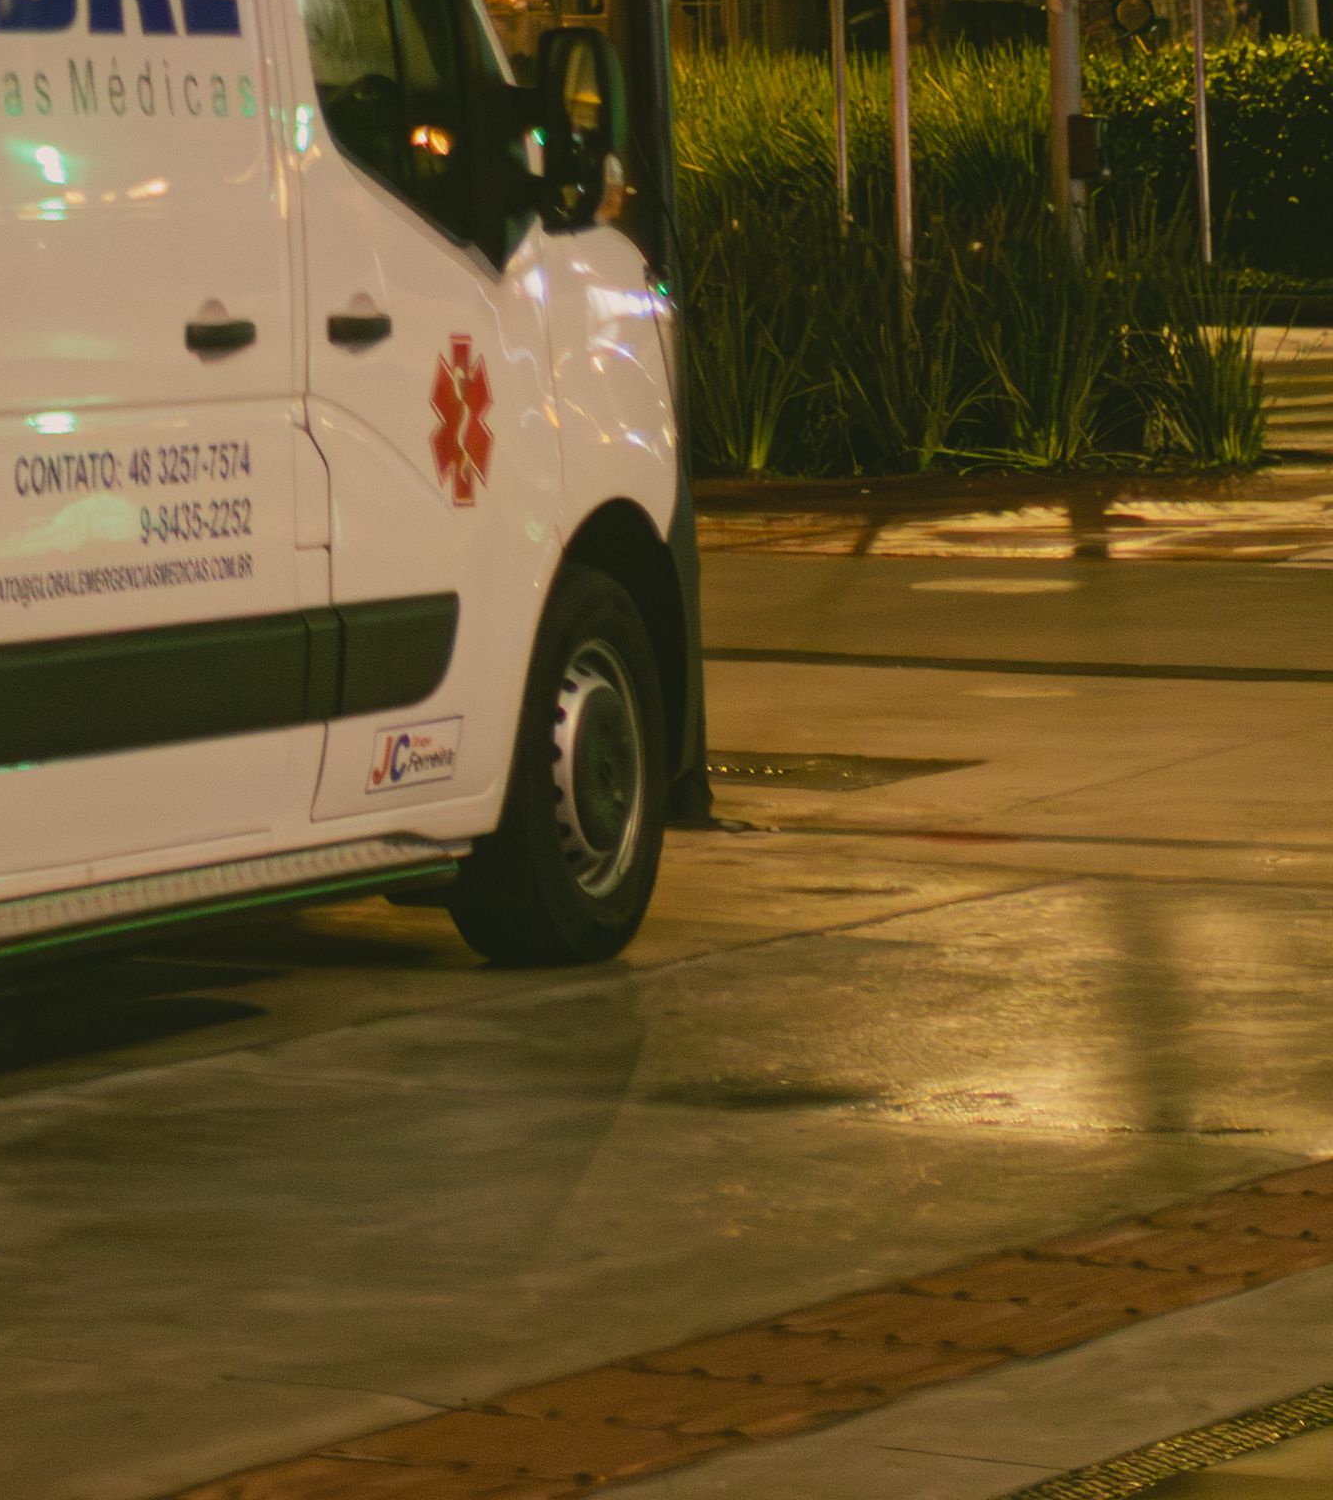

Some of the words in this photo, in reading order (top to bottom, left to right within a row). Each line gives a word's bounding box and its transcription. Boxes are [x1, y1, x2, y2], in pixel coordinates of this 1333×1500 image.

[69, 58, 255, 120] Médicas
[15, 450, 122, 496] CONTATO:
[129, 449, 151, 486] 48
[157, 439, 251, 484] 3257-7574
[140, 498, 252, 544] 9-8435-2252
[372, 734, 411, 785] JC
